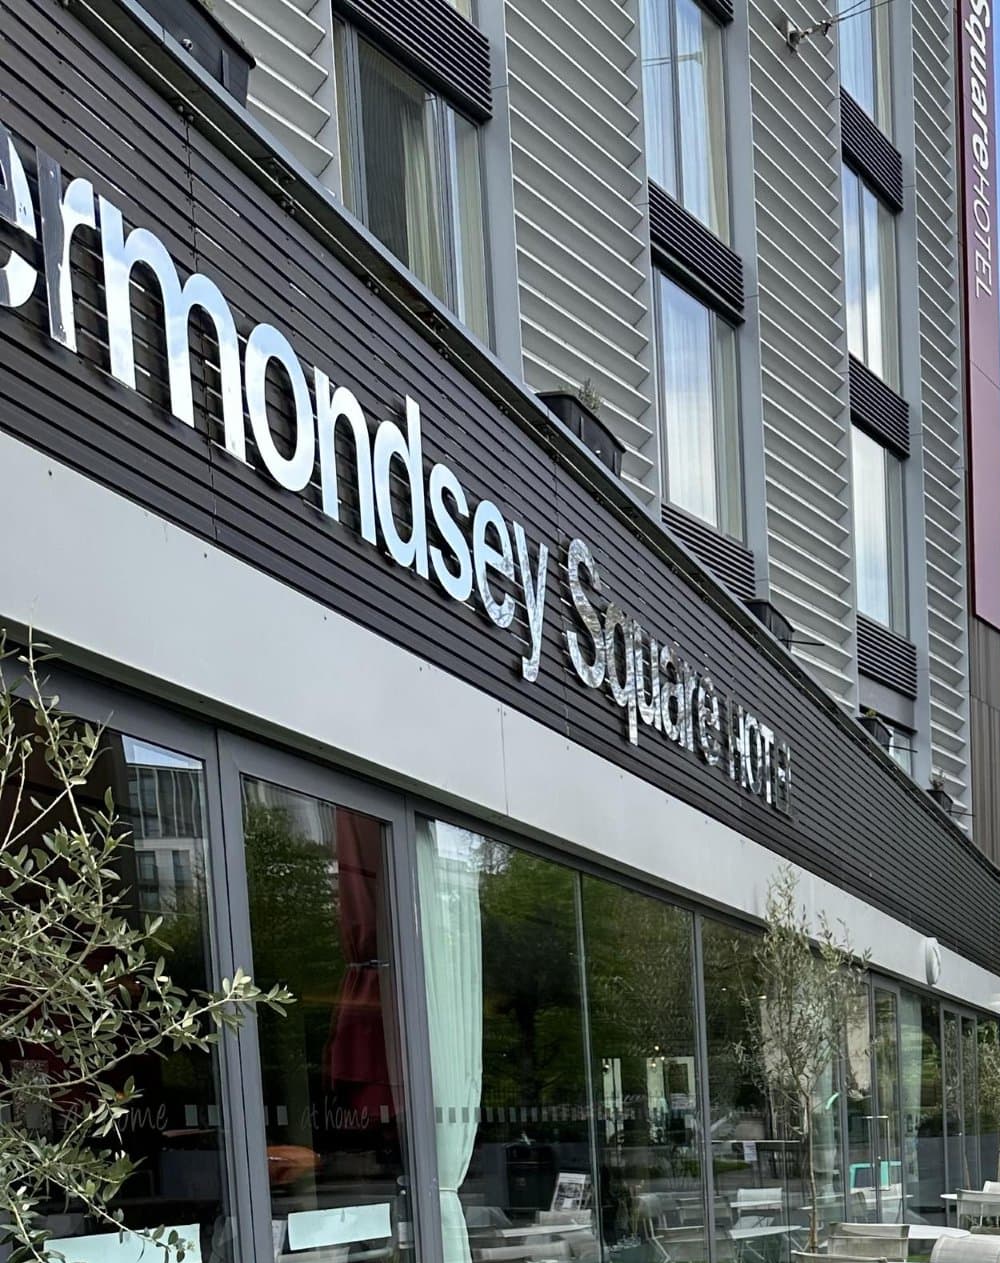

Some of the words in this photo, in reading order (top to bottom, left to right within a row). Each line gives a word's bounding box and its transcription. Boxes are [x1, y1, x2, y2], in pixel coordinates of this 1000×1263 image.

[973, 164, 993, 299] HOTEL
[566, 537, 721, 767] Square
[324, 1096, 370, 1131] home
